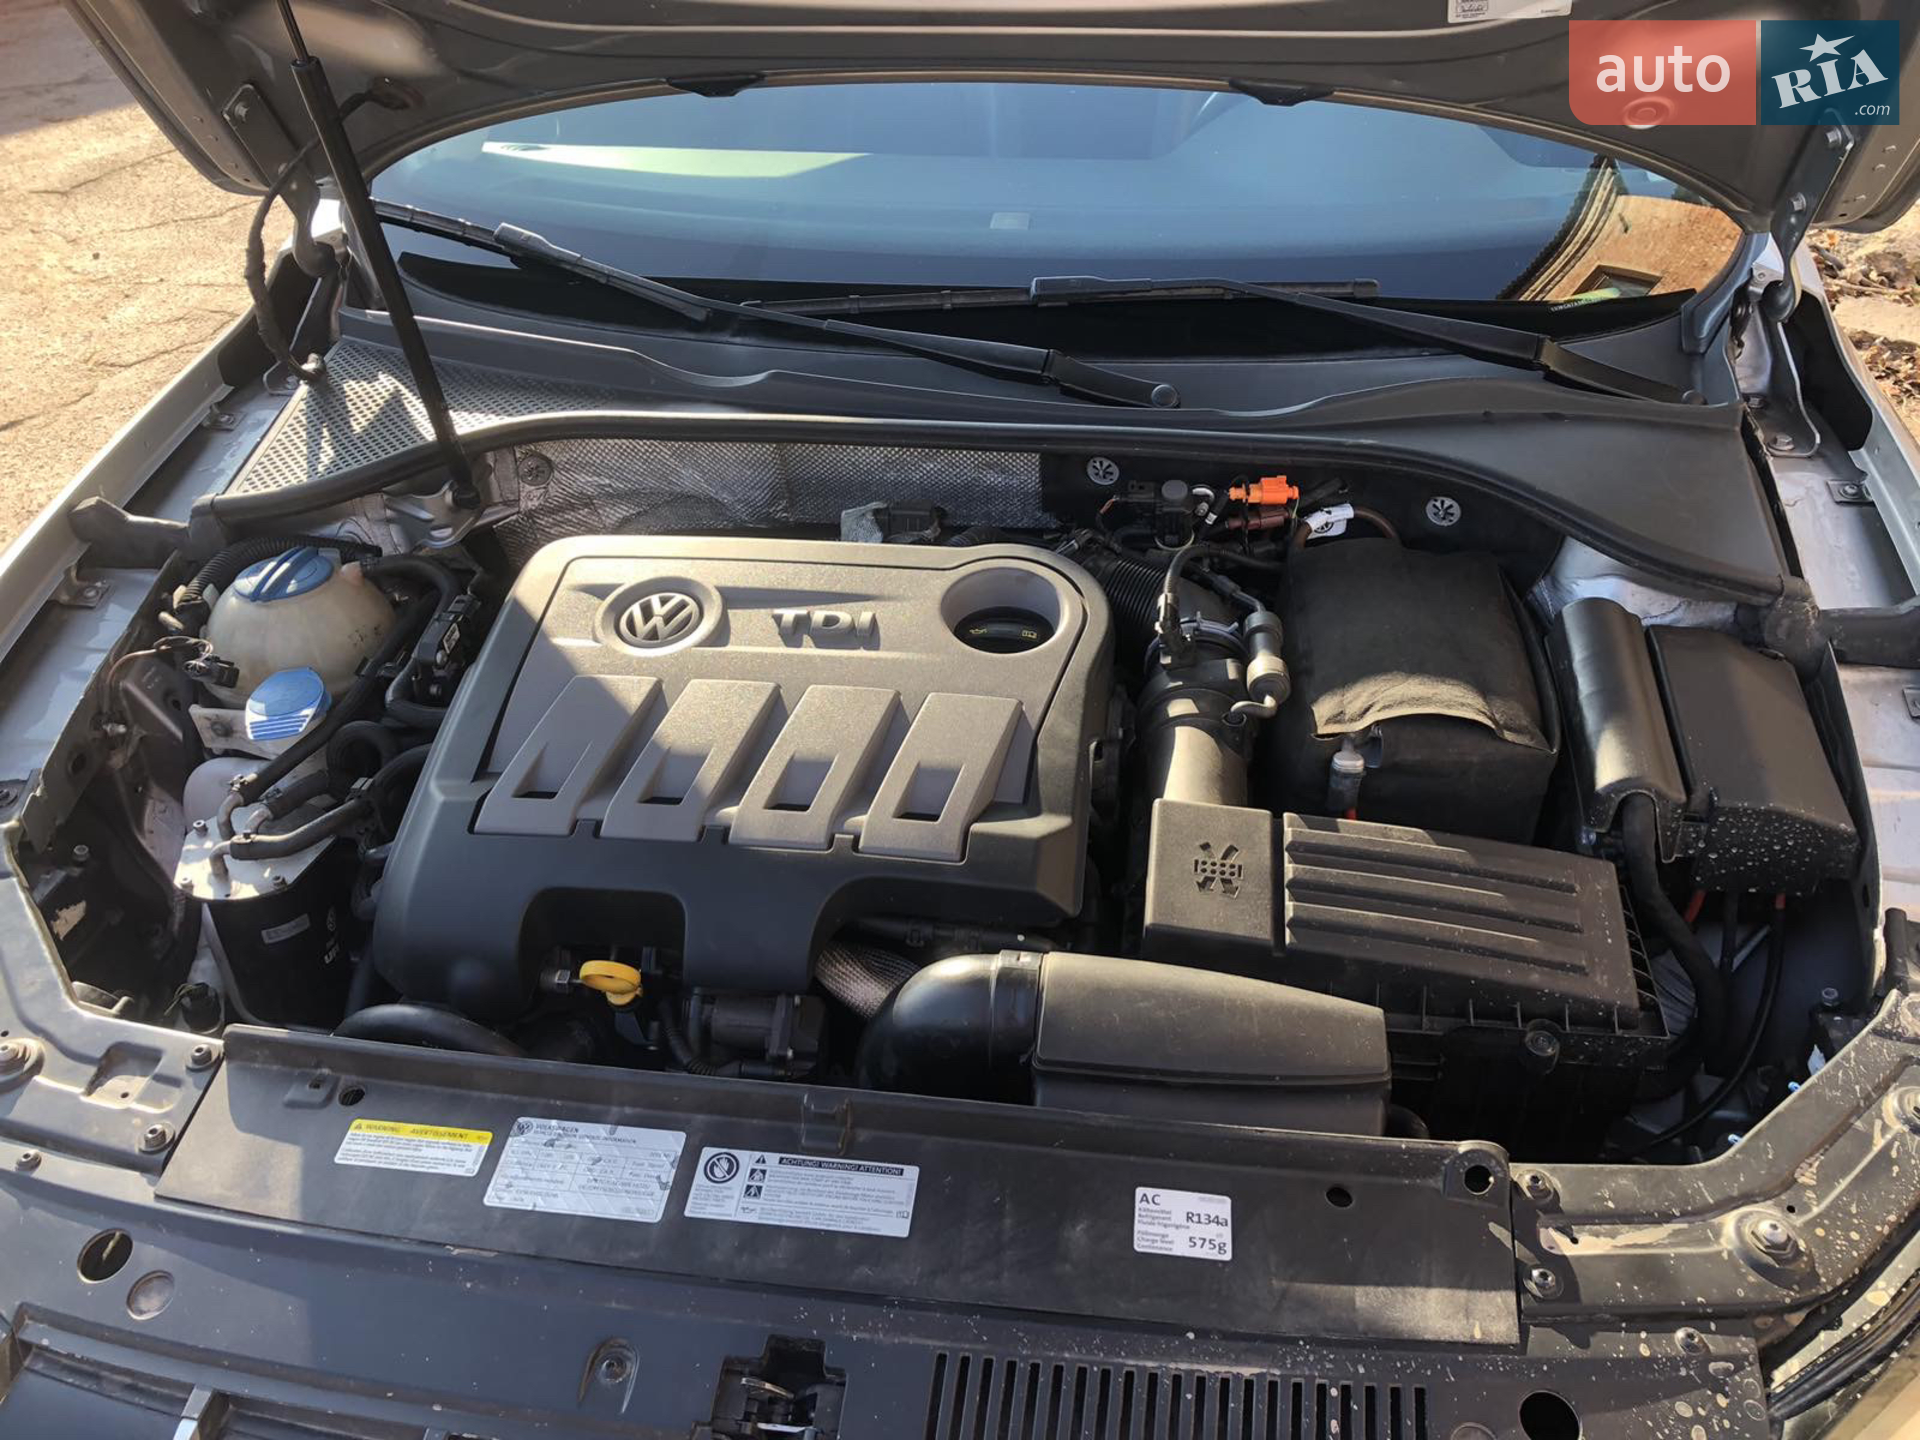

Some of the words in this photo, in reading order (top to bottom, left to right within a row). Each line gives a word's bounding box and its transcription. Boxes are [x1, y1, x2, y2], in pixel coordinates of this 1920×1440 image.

[771, 609, 878, 638] TDI
[781, 1158, 819, 1168] ACHTUNG!
[821, 1162, 858, 1171] WARNING!
[859, 1164, 902, 1175] ATTENTION!
[1139, 1193, 1161, 1206] AC
[1186, 1211, 1228, 1227] R134a
[1188, 1236, 1227, 1255] 575g
